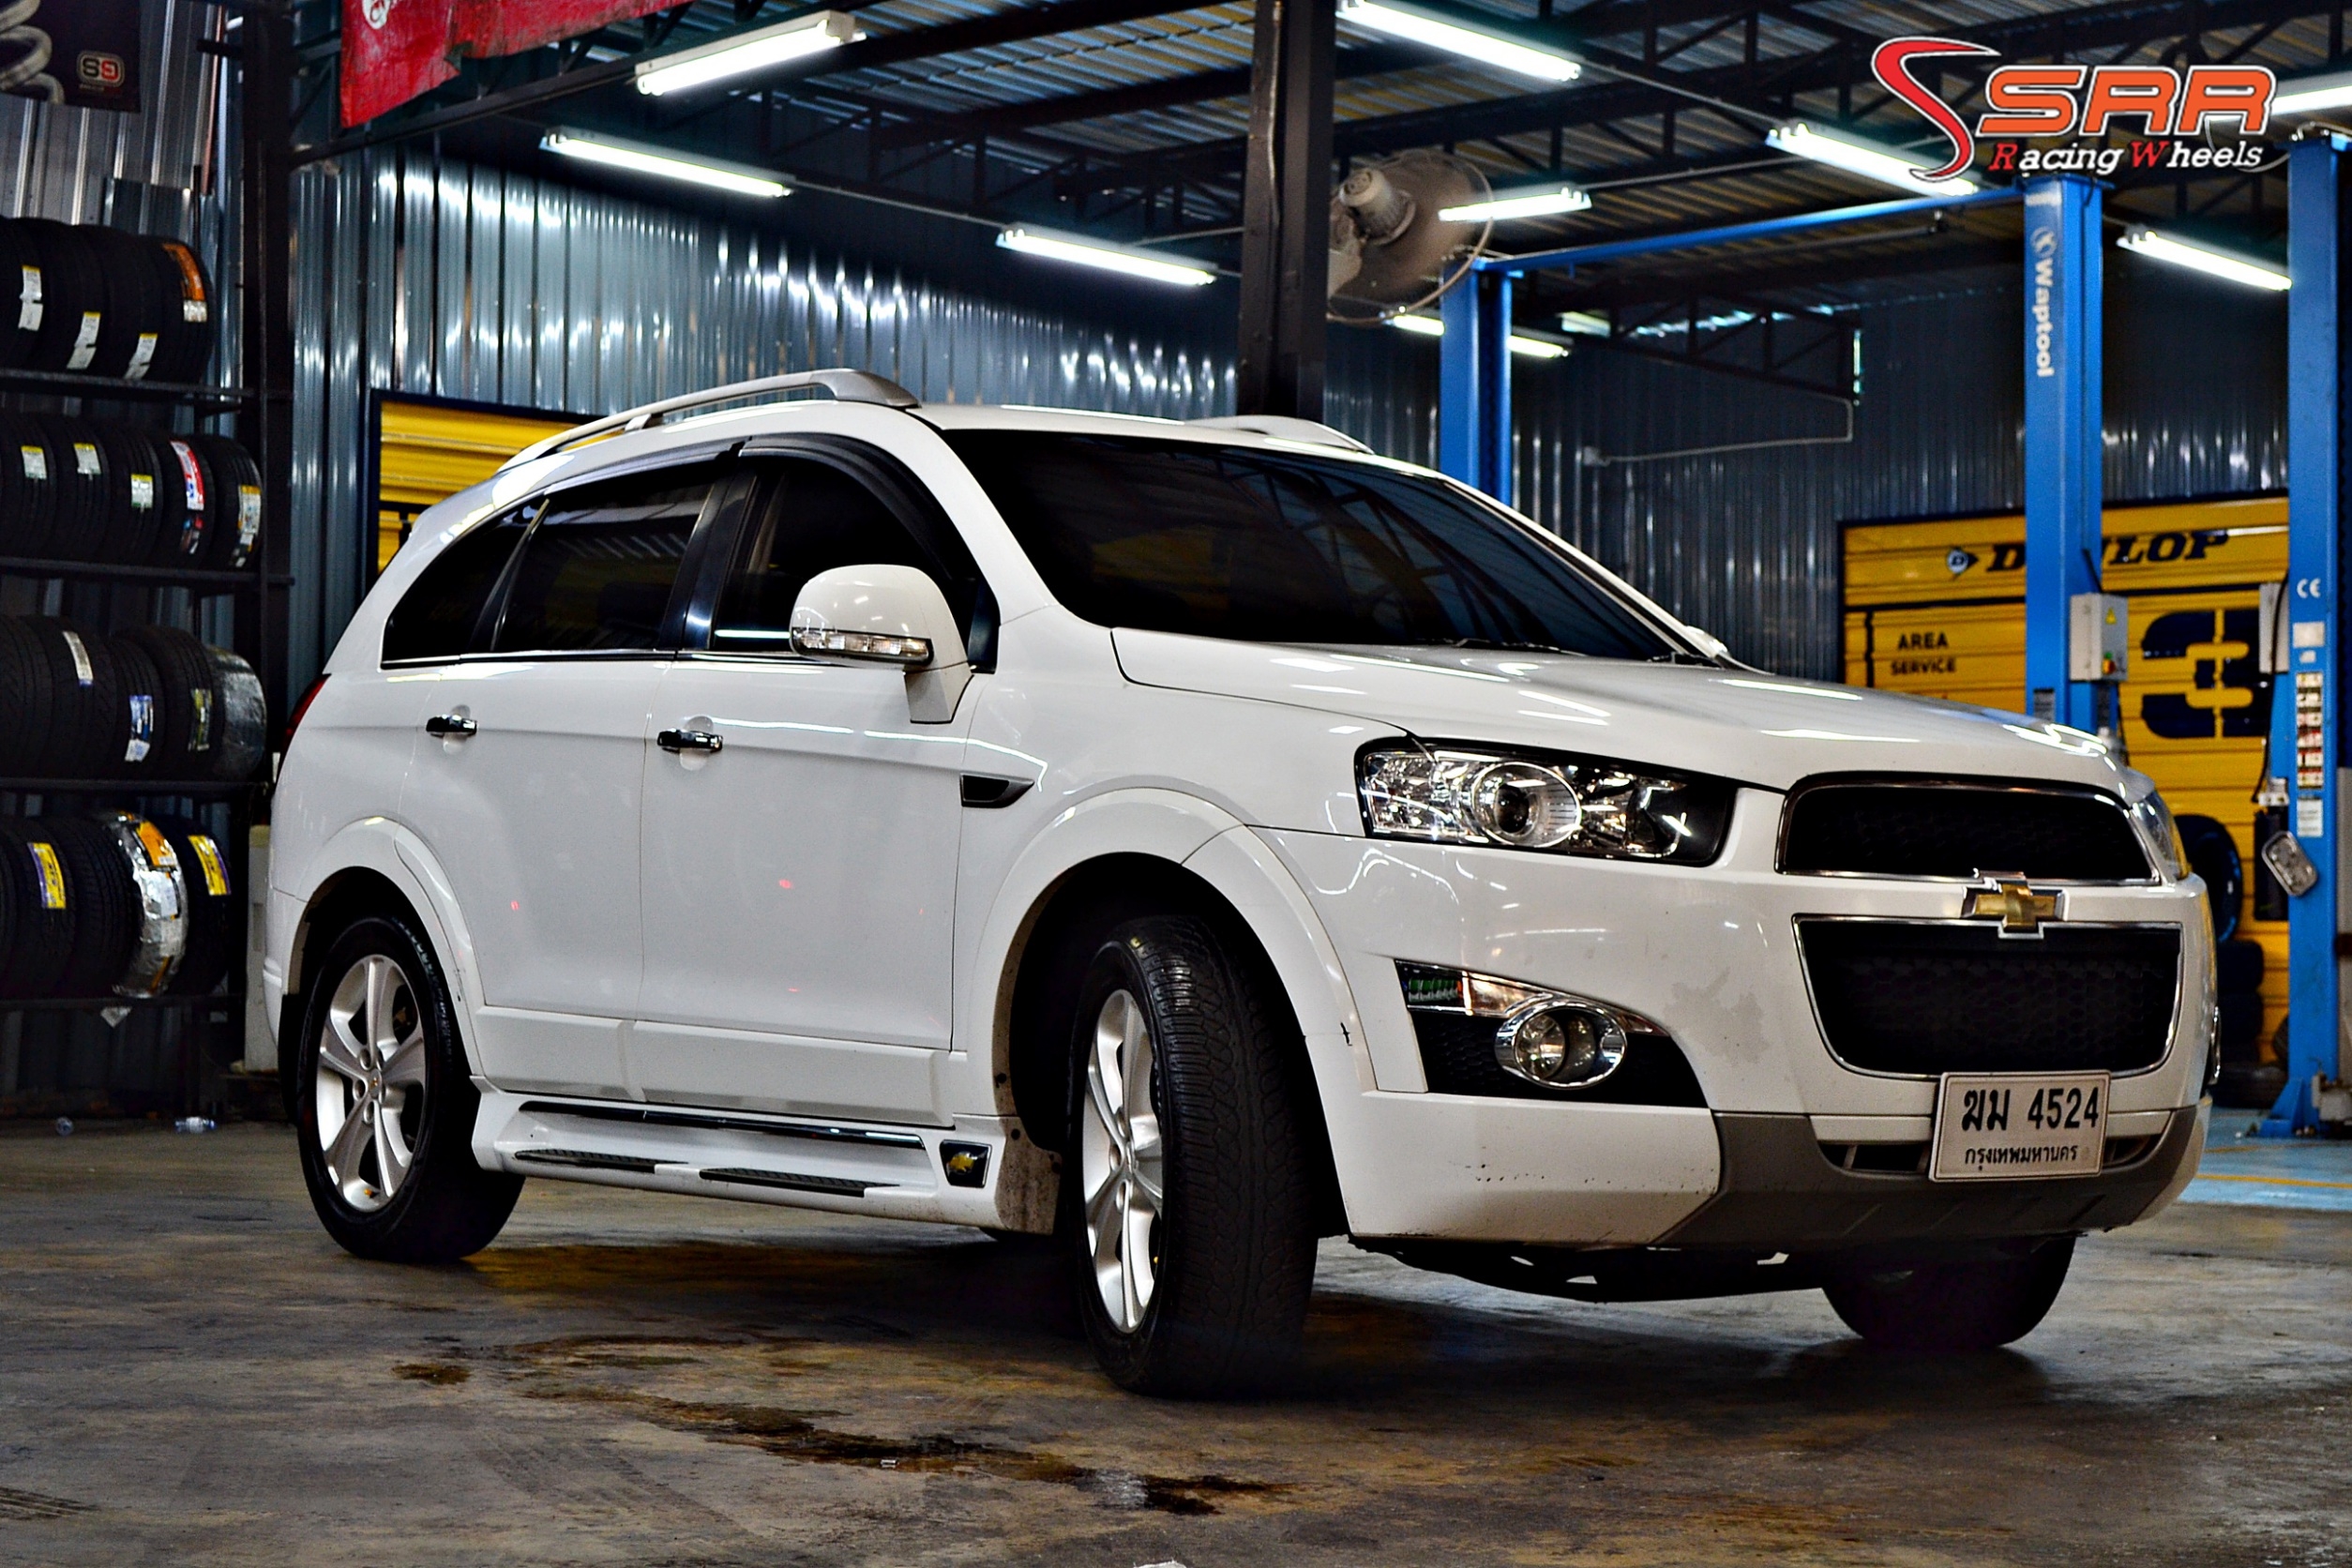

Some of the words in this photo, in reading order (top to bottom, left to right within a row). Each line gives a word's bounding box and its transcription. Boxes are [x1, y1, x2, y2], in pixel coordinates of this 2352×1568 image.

[2032, 257, 2055, 377] Waptool
[1985, 531, 2230, 572] DLOP
[1897, 631, 1949, 650] AREA
[1891, 656, 1956, 675] SERVICE
[2028, 1087, 2099, 1129] 4524
[1965, 1144, 2078, 1171] กรุงเทพมหานคร
